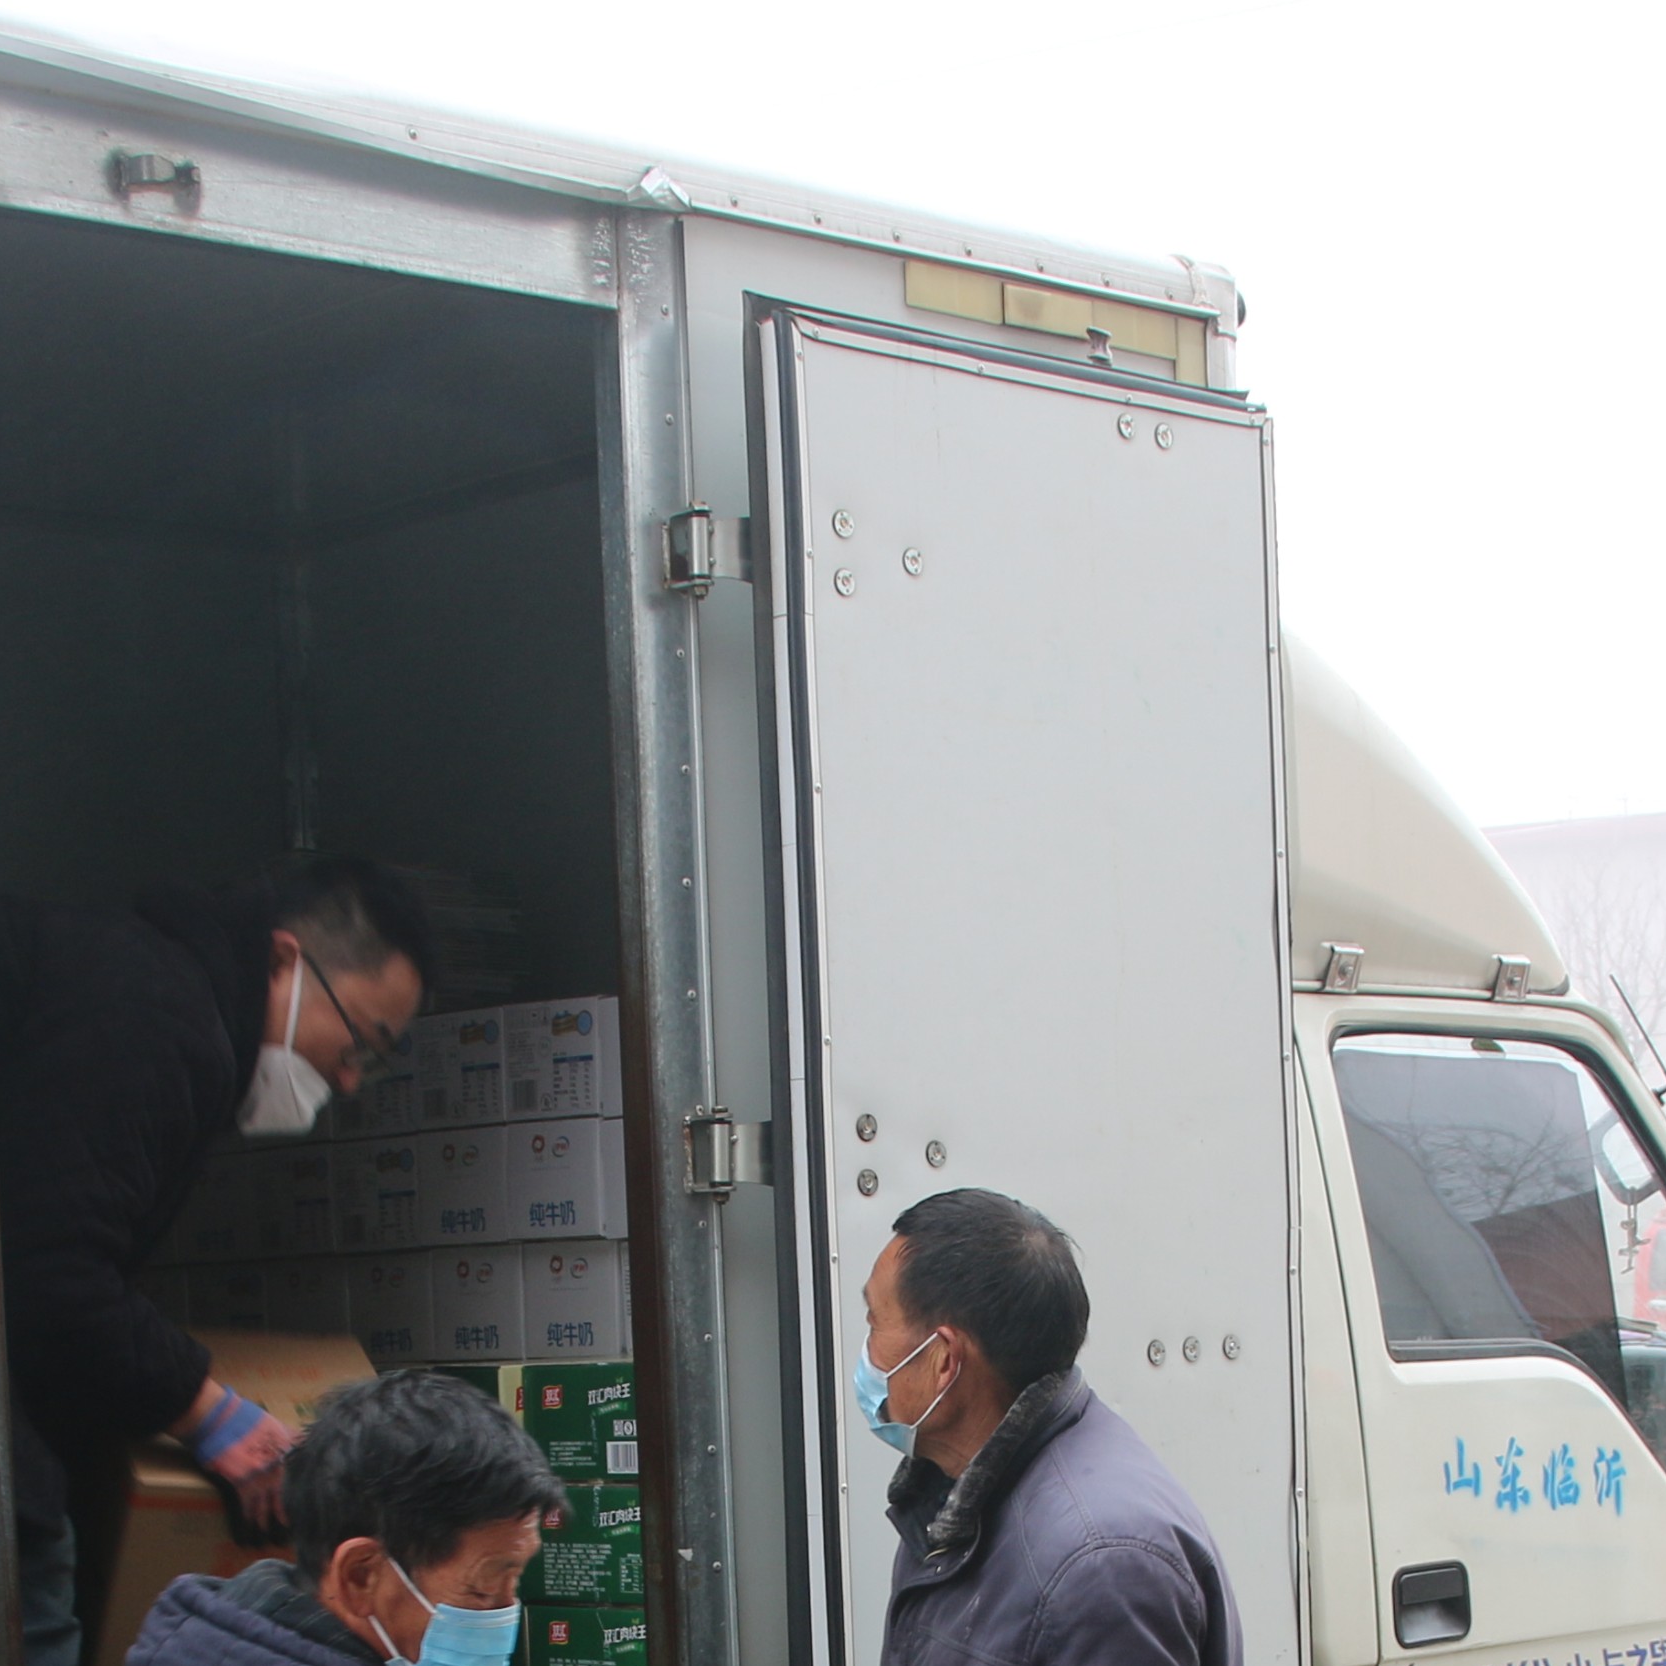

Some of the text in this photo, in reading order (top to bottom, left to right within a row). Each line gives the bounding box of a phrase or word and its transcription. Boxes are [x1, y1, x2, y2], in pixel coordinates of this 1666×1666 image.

[529, 1200, 576, 1228] 纯牛奶
[454, 1325, 499, 1350] 纯牛奶
[547, 1322, 594, 1348] 纯牛奶
[1443, 1436, 1627, 1517] 山东临沂
